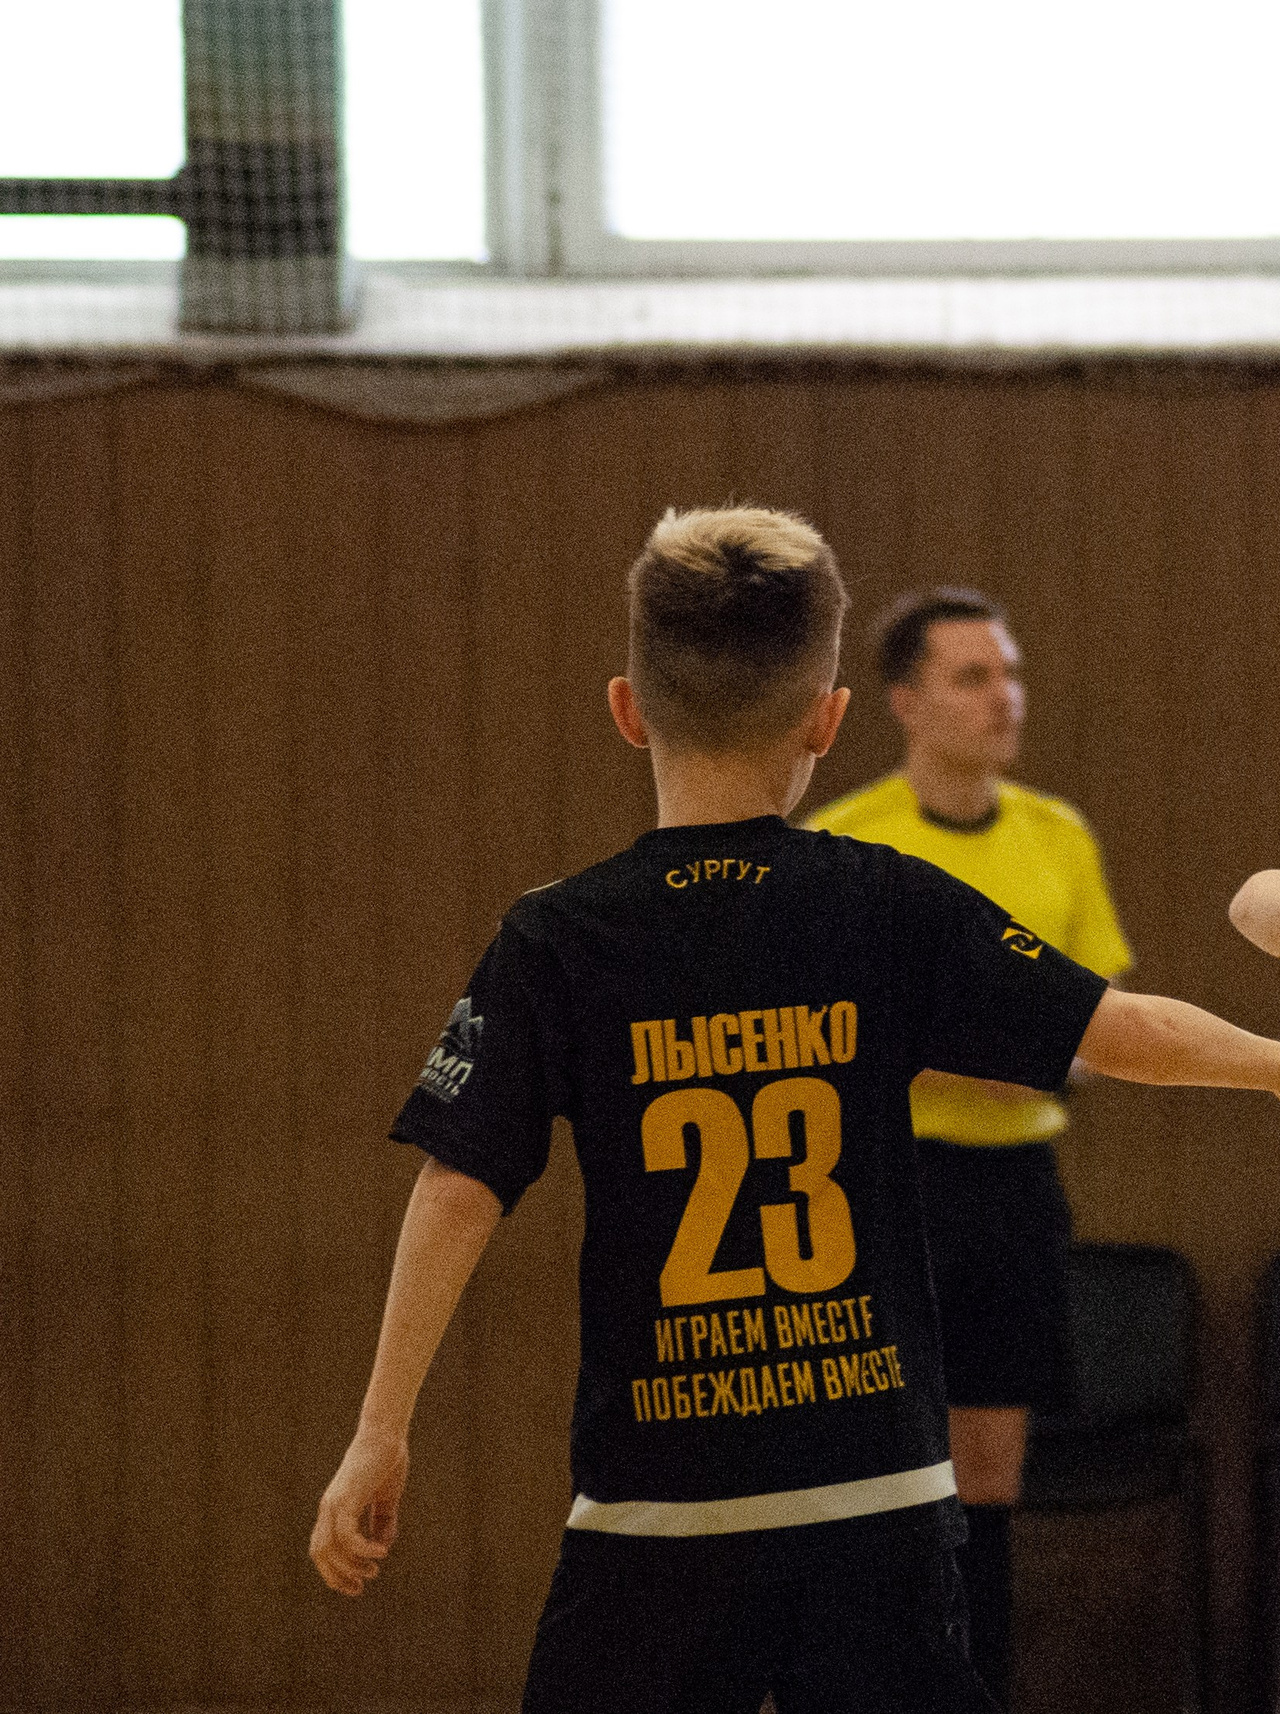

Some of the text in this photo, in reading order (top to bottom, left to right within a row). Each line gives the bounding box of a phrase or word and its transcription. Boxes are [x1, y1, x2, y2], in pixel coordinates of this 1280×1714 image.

[664, 857, 771, 889] СУРГУТ
[629, 1000, 858, 1085] ЛЫСЕНКО
[640, 1076, 857, 1308] 23
[654, 1295, 874, 1363] ИГРАЕМ ВМЕСТЕ
[631, 1345, 906, 1422] ПОБЕЖДАЕМ ВМЕСТЕ
